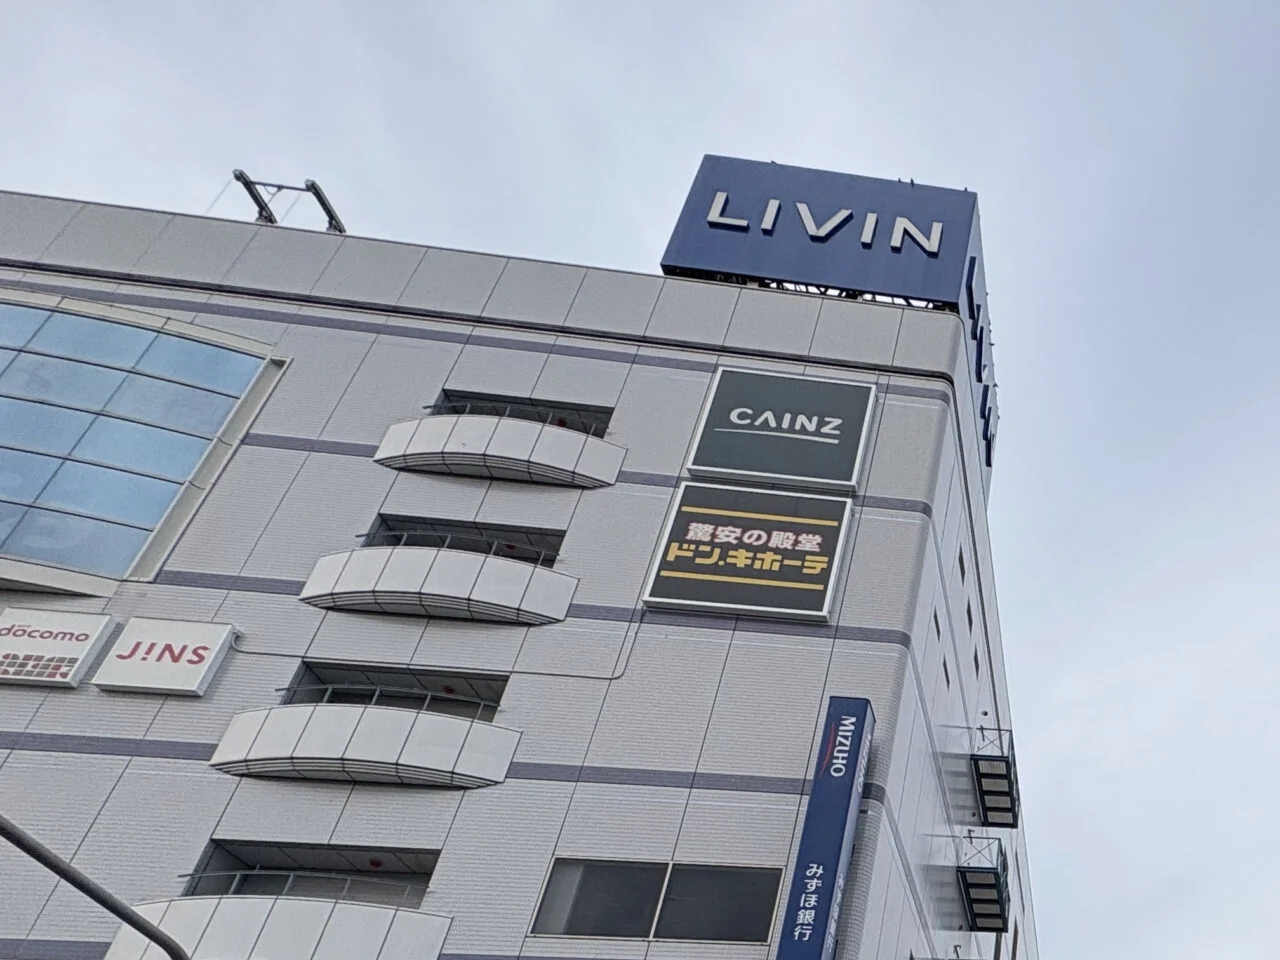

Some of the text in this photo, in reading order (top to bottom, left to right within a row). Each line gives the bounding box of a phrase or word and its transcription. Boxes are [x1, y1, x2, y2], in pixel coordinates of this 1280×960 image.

[707, 191, 944, 257] LIVIN
[729, 407, 844, 435] CAINZ
[685, 522, 823, 552] 驚安の殿堂
[0, 624, 90, 642] docomo
[830, 715, 857, 777] MIZUHO
[793, 863, 824, 941] みずほ銀行
